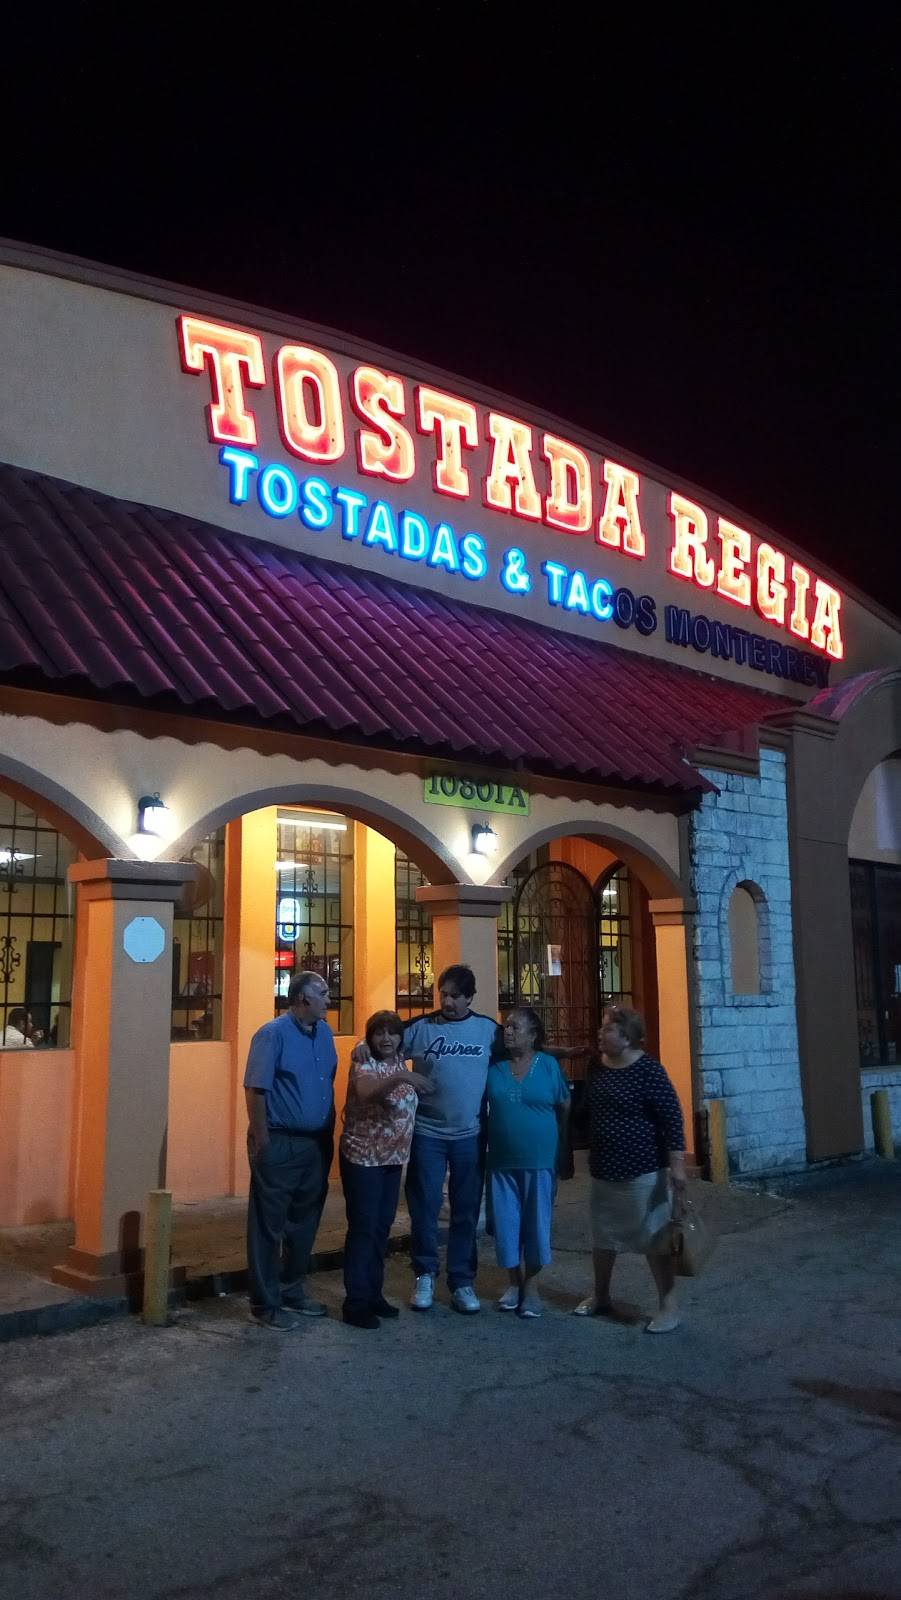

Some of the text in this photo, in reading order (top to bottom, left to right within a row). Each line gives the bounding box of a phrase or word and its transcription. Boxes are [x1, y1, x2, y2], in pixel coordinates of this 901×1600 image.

[177, 314, 844, 661] TOSTADA REGIA
[218, 446, 831, 690] TOSTADAS & TACOS MONTERREY
